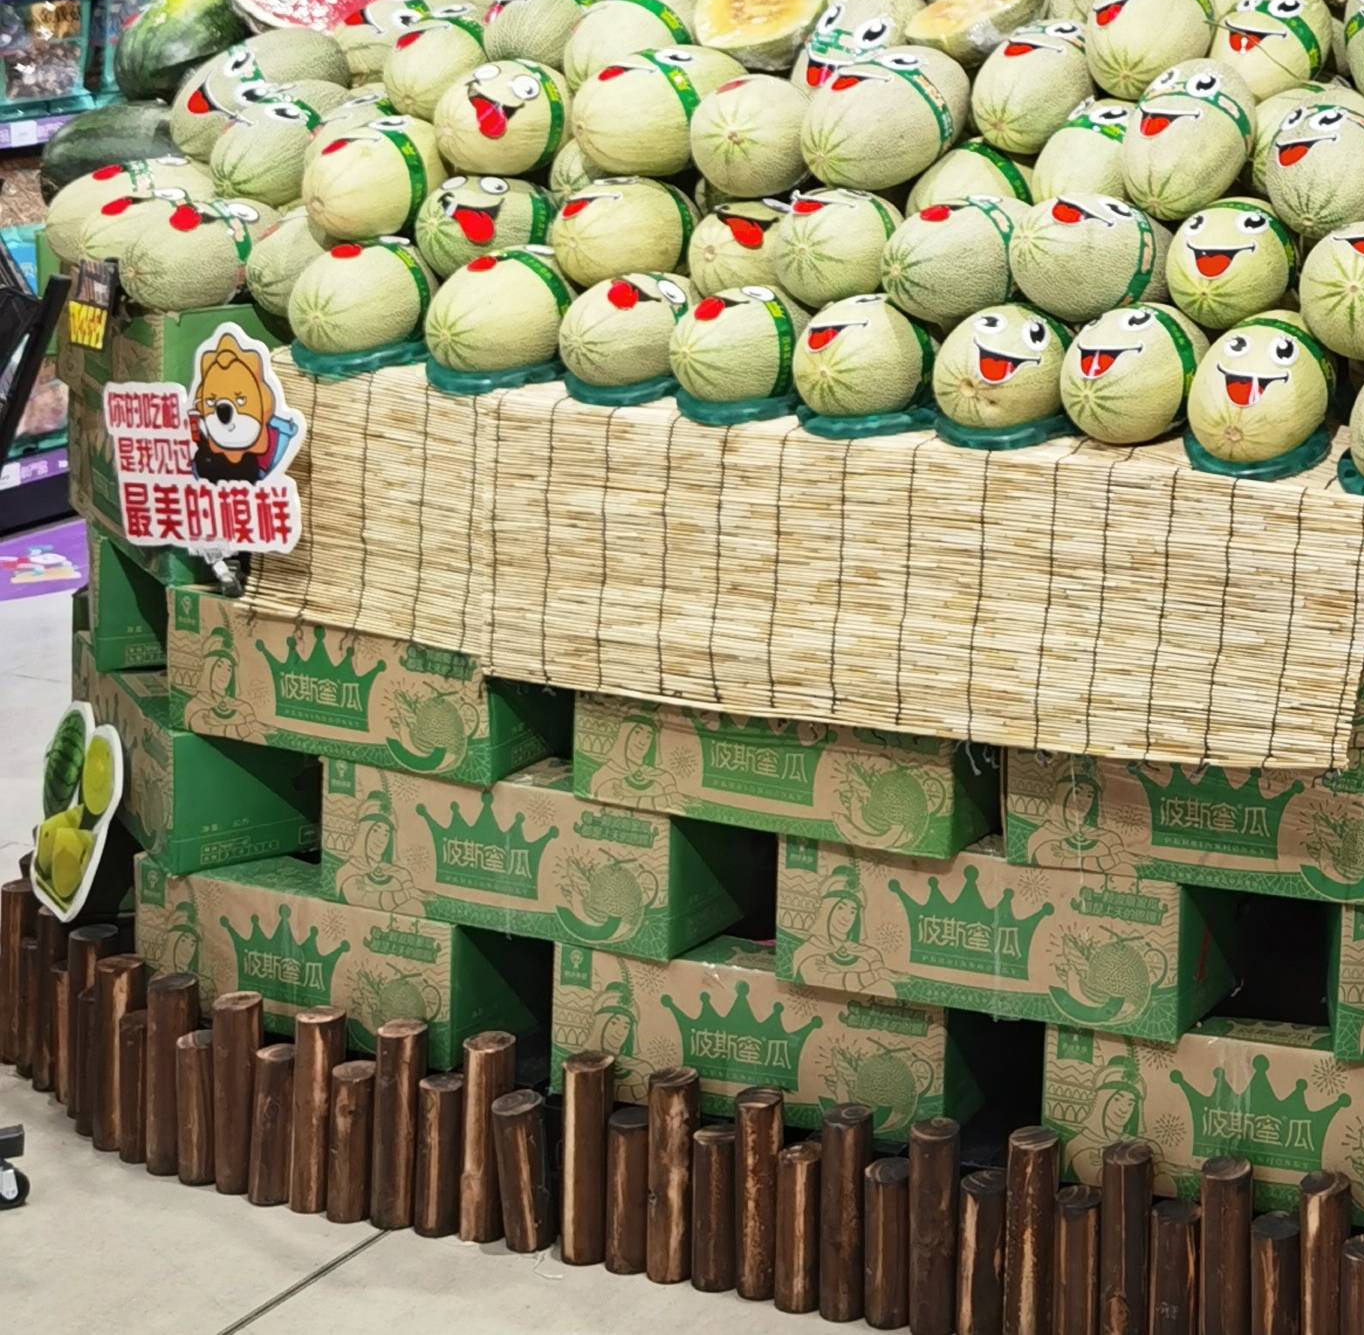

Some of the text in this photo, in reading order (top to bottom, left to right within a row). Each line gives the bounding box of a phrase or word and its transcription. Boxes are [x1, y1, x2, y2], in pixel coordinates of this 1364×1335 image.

[118, 436, 195, 476] 是我见过
[123, 481, 293, 546] 最美的模样
[278, 670, 363, 712] 波斯蜜瓜
[710, 739, 809, 784] 波斯蜜瓜
[1160, 796, 1272, 838] 波斯蜜瓜
[441, 836, 533, 880] 波斯蜜瓜
[918, 913, 1023, 960] 波斯蜜瓜
[243, 948, 326, 992] 波斯蜜瓜
[690, 1027, 791, 1070] 波斯蜜瓜
[1201, 1105, 1315, 1153] 波斯蜜瓜
